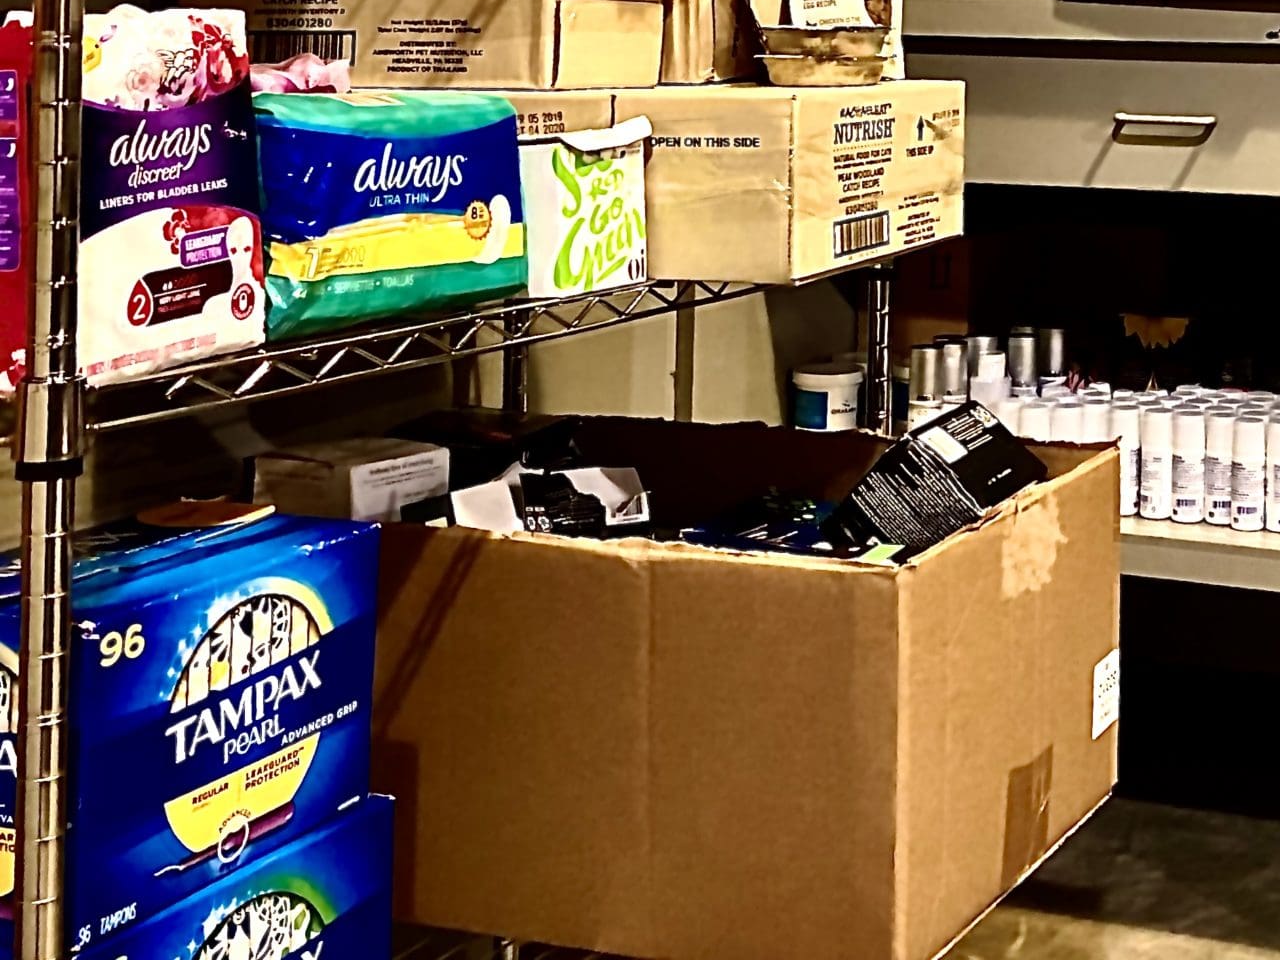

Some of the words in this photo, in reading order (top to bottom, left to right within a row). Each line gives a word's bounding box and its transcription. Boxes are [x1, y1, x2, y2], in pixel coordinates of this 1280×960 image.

[415, 48, 429, 57] PET
[470, 48, 484, 57] LLC
[386, 65, 420, 74] PRODUCT
[421, 65, 432, 74] OF
[528, 113, 540, 124] 05
[542, 110, 564, 123] 2019
[543, 122, 566, 134] 2020
[109, 118, 213, 172] always
[650, 136, 681, 149] OPEN
[684, 136, 702, 149] ON
[704, 136, 732, 149] THIS
[733, 136, 761, 149] SIDE
[127, 161, 185, 189] discreet
[353, 141, 466, 203] always
[99, 193, 135, 211] LINERS
[136, 190, 156, 204] FOR
[156, 183, 200, 201] BLADDER
[200, 177, 229, 191] LEAKS
[368, 193, 402, 209] ULTRA
[404, 191, 431, 204] THIN
[470, 205, 479, 221] 8
[132, 293, 147, 322] 2
[99, 622, 146, 668] 96
[164, 648, 323, 765] TAMPAX
[280, 713, 335, 747] ADVANCED
[335, 700, 359, 720] GRIP
[244, 757, 302, 792] PROTECTION
[191, 781, 230, 806] REGULAR
[99, 901, 138, 937] TAMPONS
